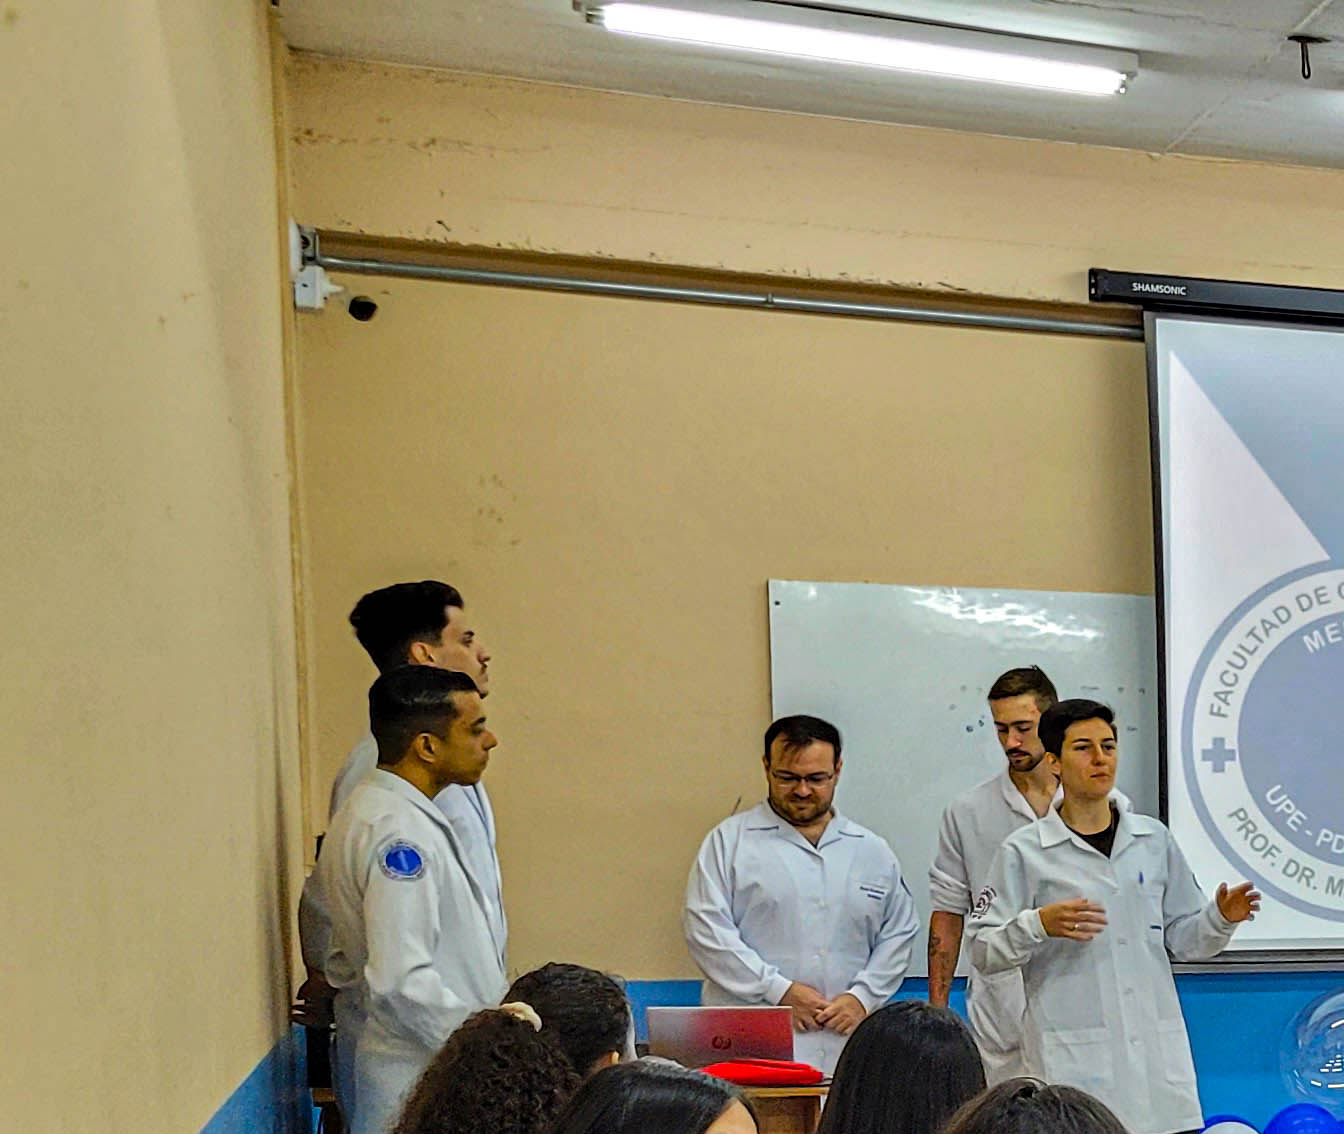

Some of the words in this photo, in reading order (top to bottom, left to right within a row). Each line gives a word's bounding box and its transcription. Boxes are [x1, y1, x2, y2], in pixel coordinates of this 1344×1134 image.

[1132, 282, 1187, 296] SHAMSONIC
[1209, 605, 1292, 718] FACULTAD
[1296, 586, 1331, 613] DE
[1265, 784, 1308, 833] UPE
[1227, 807, 1283, 868] PROF.
[1282, 859, 1318, 891] DR.
